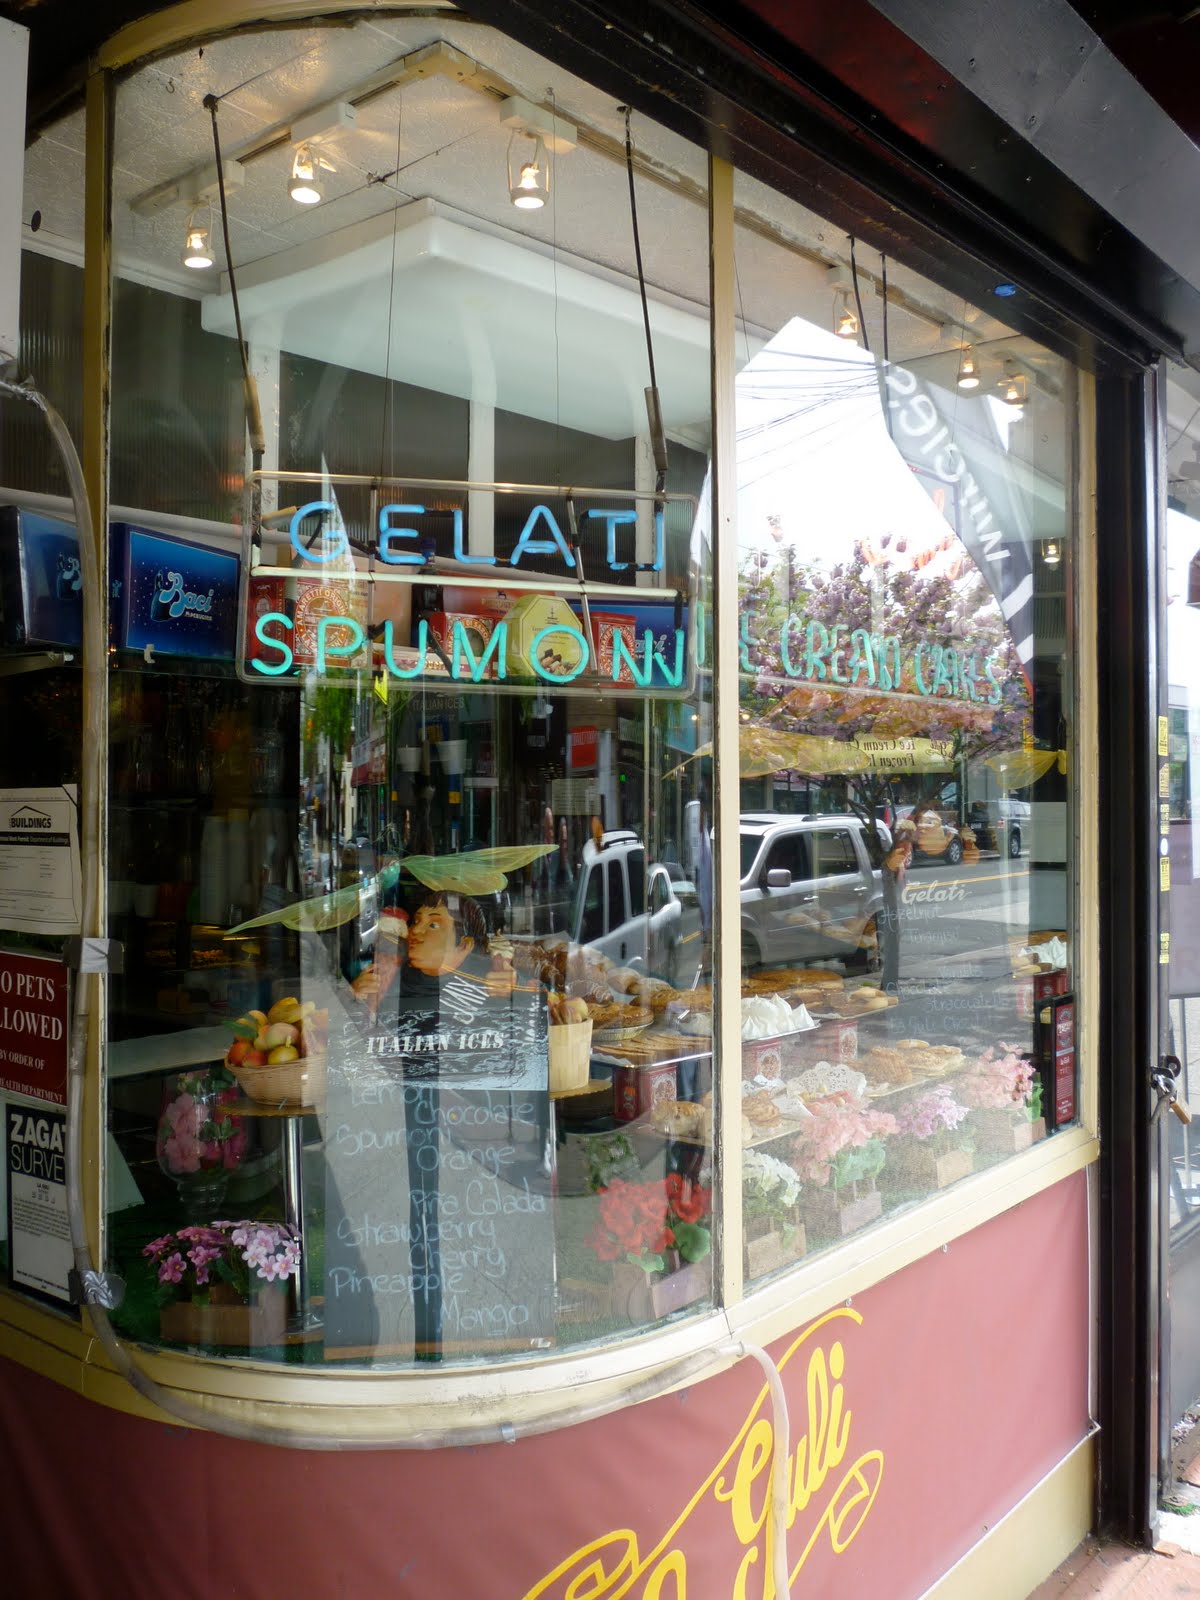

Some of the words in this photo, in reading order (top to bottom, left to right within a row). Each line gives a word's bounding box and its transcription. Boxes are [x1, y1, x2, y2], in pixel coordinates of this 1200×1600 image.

[289, 501, 664, 571] GELATI
[158, 571, 215, 618] Baci
[297, 588, 322, 626] AMARETTI
[11, 818, 52, 829] BUILDINGS
[902, 880, 973, 905] Gelati
[0, 971, 12, 993] O
[16, 973, 55, 1002] PETS
[0, 1007, 63, 1041] LOWED
[366, 1033, 453, 1054] ITALIAN
[458, 1030, 505, 1051] ICES
[8, 1051, 34, 1067] ORDER
[34, 1058, 46, 1070] OF
[21, 1081, 63, 1103] DEPARTMENT
[414, 1090, 534, 1124] Chocolate
[336, 1124, 453, 1155] Spumoni
[10, 1144, 65, 1183] SURVE
[416, 1145, 516, 1180] Orange
[466, 1176, 547, 1216] Colada
[336, 1212, 497, 1250] Strawberry
[408, 1244, 508, 1278] Cherry
[328, 1266, 472, 1305] Pineapple
[440, 1296, 530, 1337] Mango
